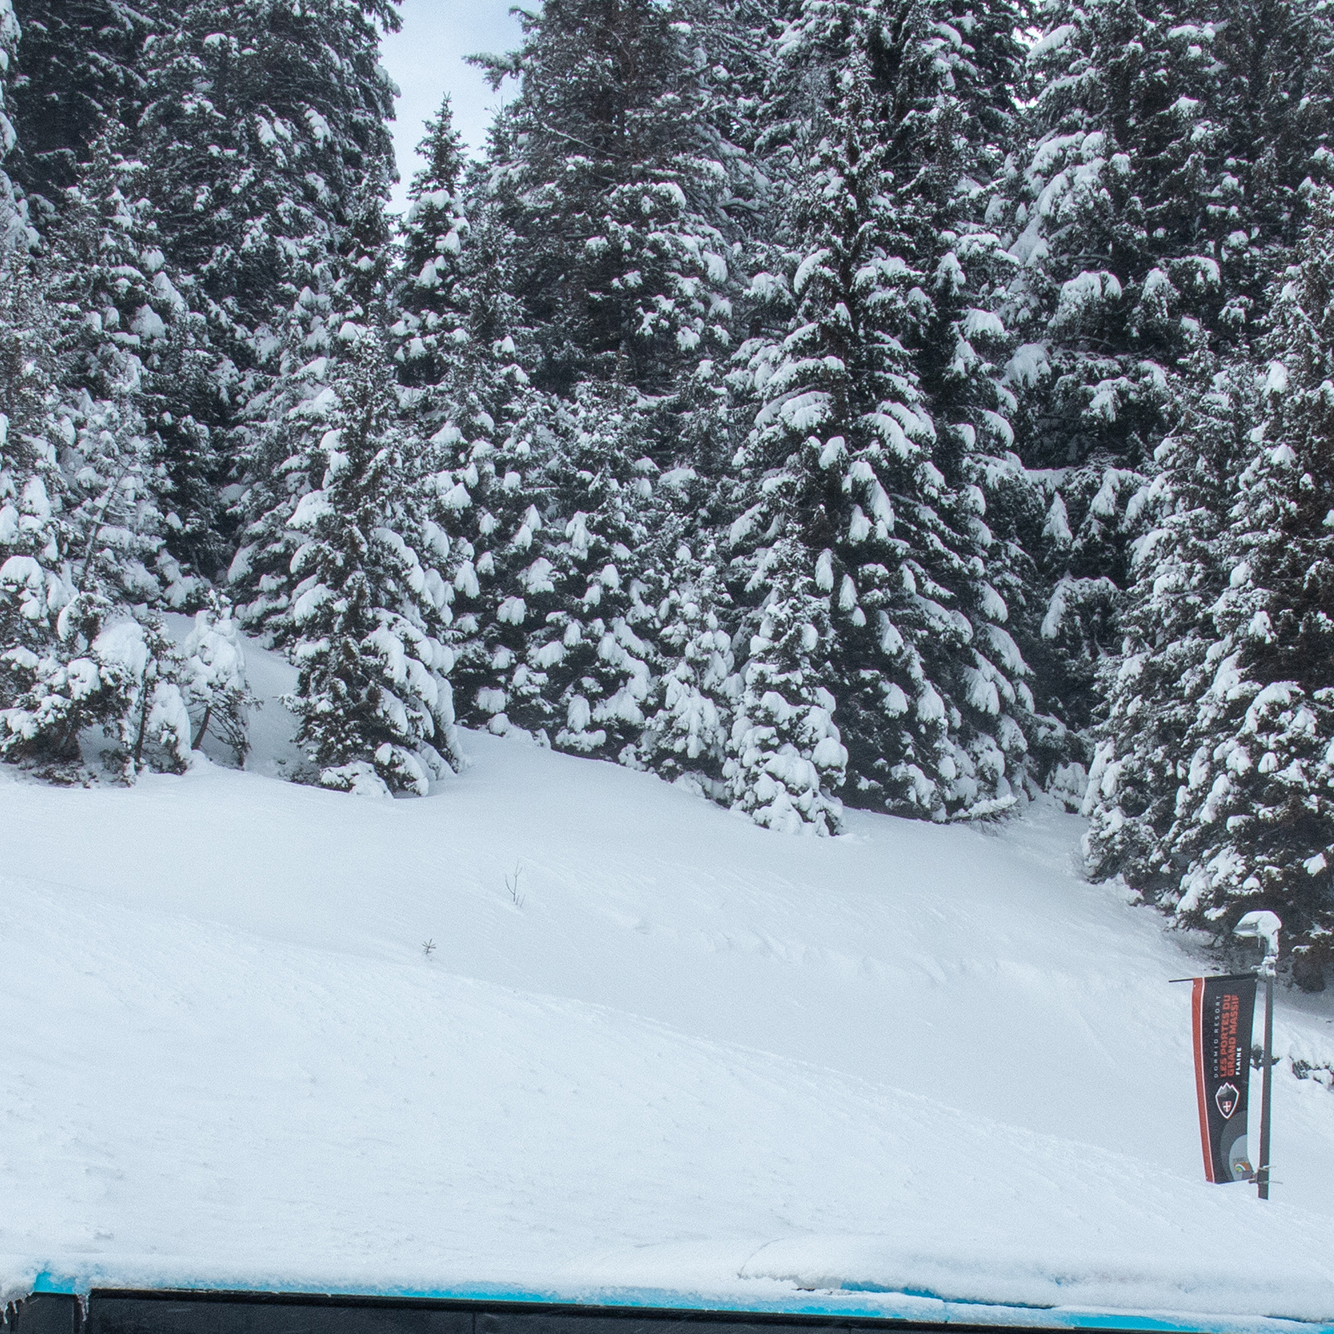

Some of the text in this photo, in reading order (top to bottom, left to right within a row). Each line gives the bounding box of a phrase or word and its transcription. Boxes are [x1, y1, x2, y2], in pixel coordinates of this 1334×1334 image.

[1213, 995, 1221, 1034] RESORT
[1220, 994, 1231, 1078] LES PORTES DU
[1227, 994, 1239, 1077] GRAND MASSIF
